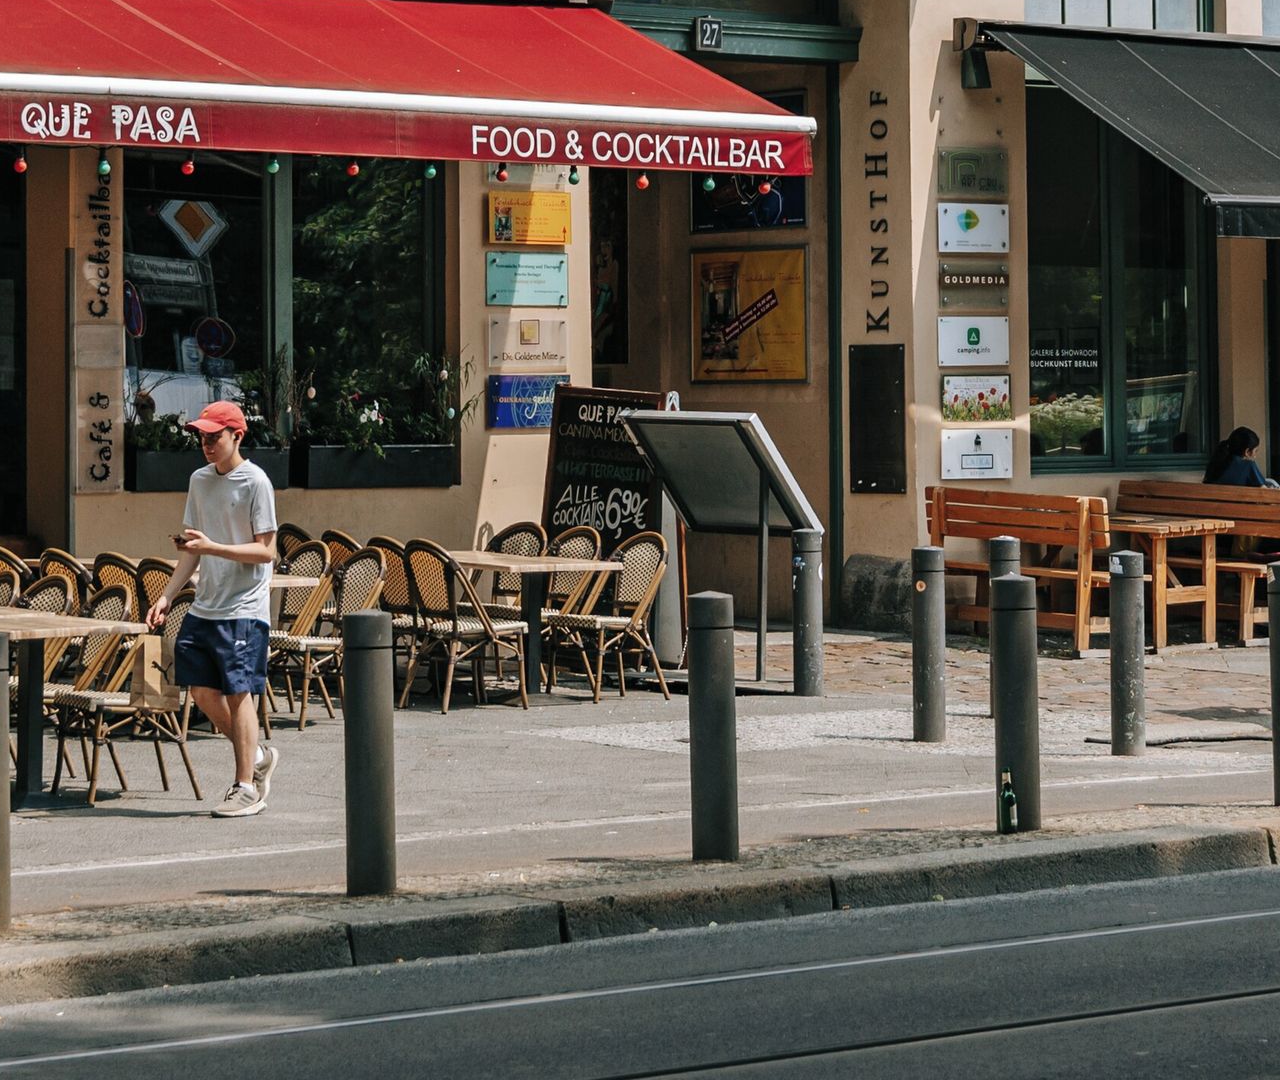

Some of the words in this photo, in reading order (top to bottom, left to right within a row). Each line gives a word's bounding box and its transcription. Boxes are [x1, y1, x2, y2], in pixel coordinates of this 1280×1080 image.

[702, 23, 720, 47] 27
[21, 101, 91, 140] QUE
[111, 105, 200, 143] PASA
[472, 124, 555, 160] FOOD
[564, 128, 584, 161] &
[592, 131, 785, 170] COCKTAILBAR
[865, 90, 890, 334] KUNSTHOF
[87, 170, 111, 319] Cocktailba
[944, 275, 1006, 284] GOLDMEDIA
[502, 352, 513, 360] Die
[514, 351, 541, 360] Goldene
[541, 351, 558, 360] Mitte
[1030, 349, 1054, 357] GALERIE
[1055, 349, 1060, 357] &
[1061, 349, 1098, 357] SHOWROOM
[1030, 360, 1072, 368] BUCHKUNST
[1074, 360, 1098, 368] BERLIN
[89, 391, 111, 410] &
[579, 404, 603, 423] QUE
[607, 405, 638, 425] PA
[559, 423, 602, 440] CANTINA
[89, 418, 113, 483] Café
[555, 484, 599, 509] ALLE
